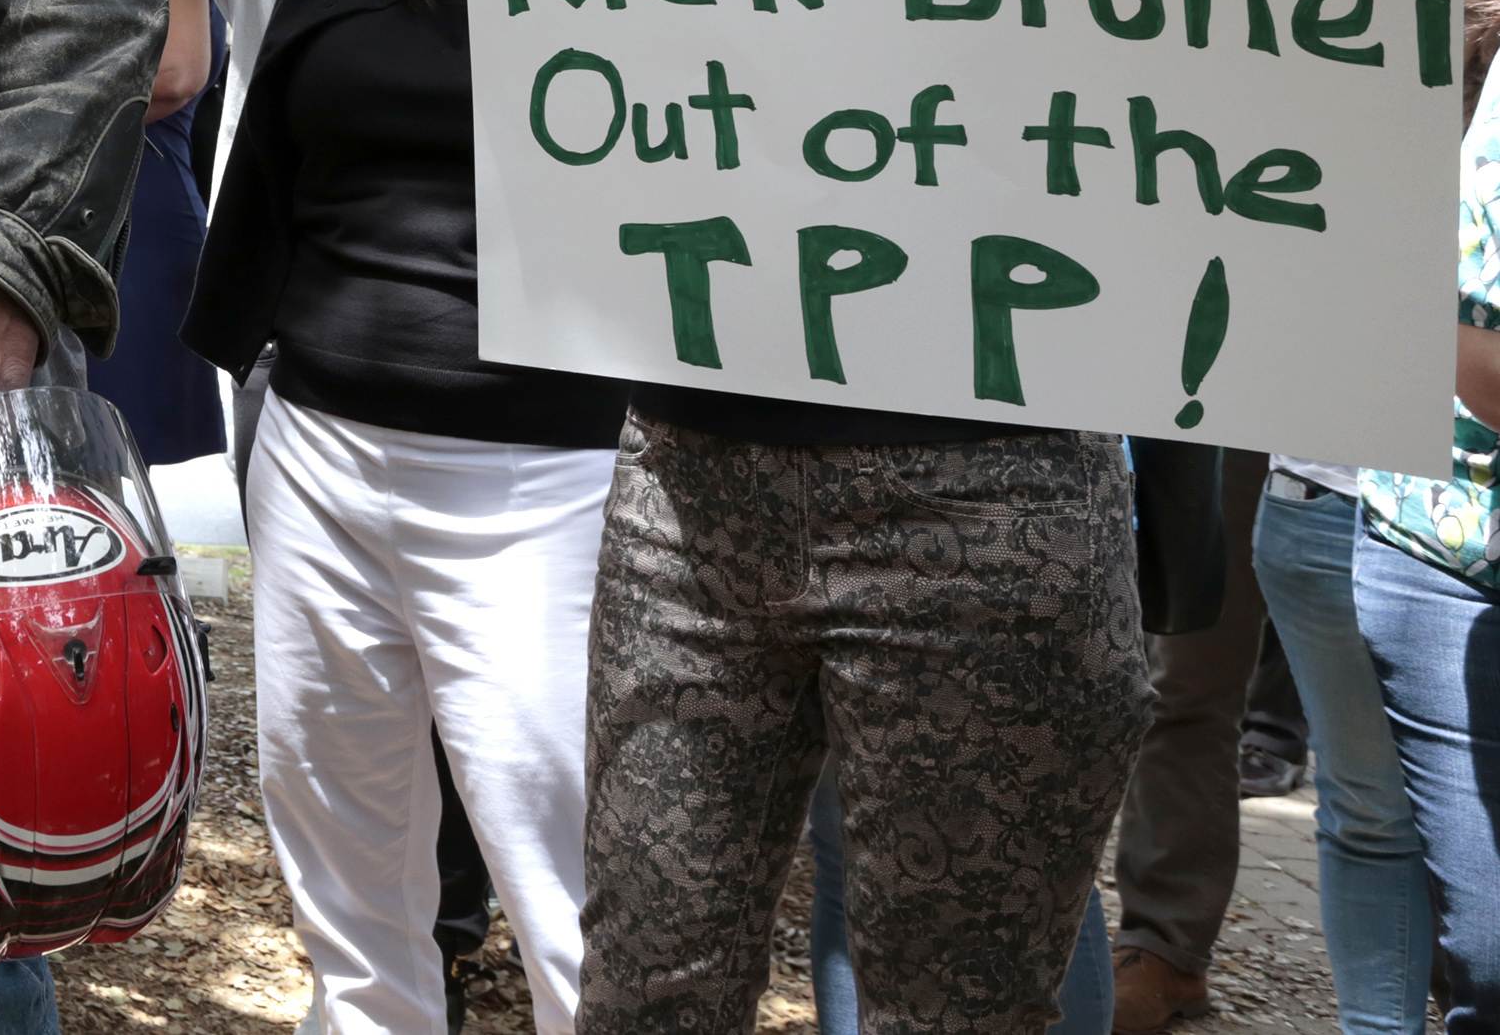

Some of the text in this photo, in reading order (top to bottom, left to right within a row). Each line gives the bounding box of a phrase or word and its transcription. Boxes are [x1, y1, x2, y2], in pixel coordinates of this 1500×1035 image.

[529, 47, 1327, 233] Out of the
